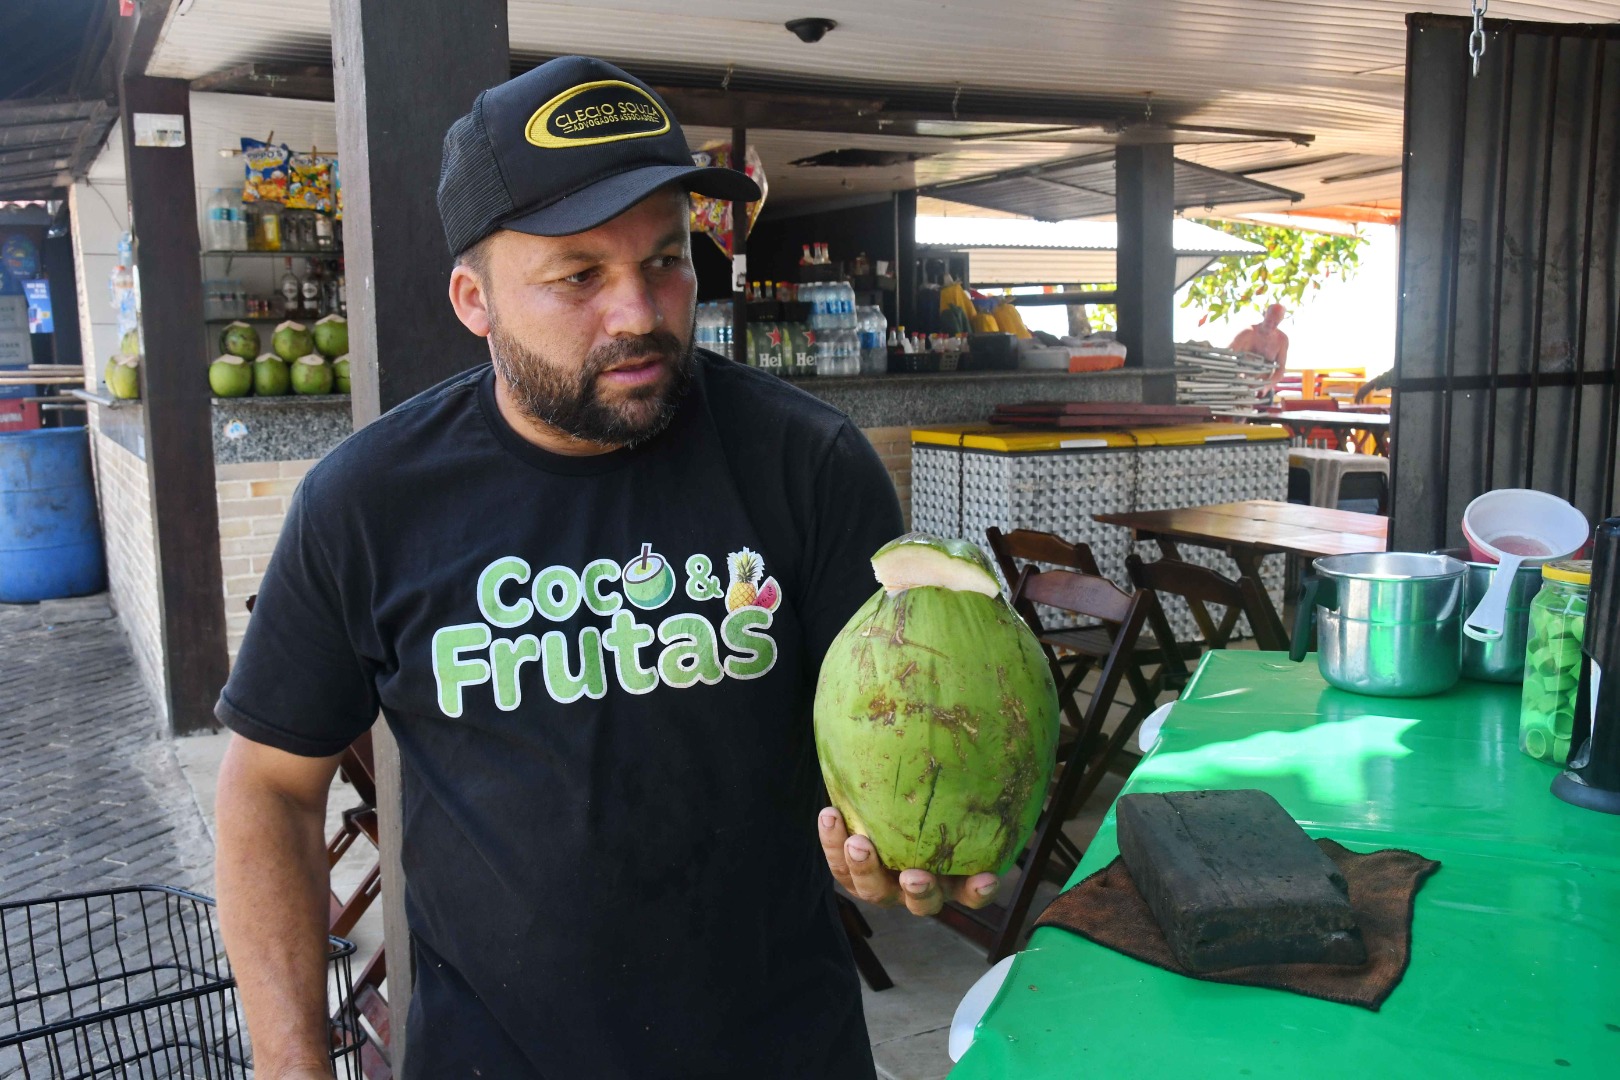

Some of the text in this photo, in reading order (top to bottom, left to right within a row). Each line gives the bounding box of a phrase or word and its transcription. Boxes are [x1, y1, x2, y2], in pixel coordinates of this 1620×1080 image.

[555, 102, 661, 127] CLECIO SOUZA
[431, 604, 778, 719] Frutas
